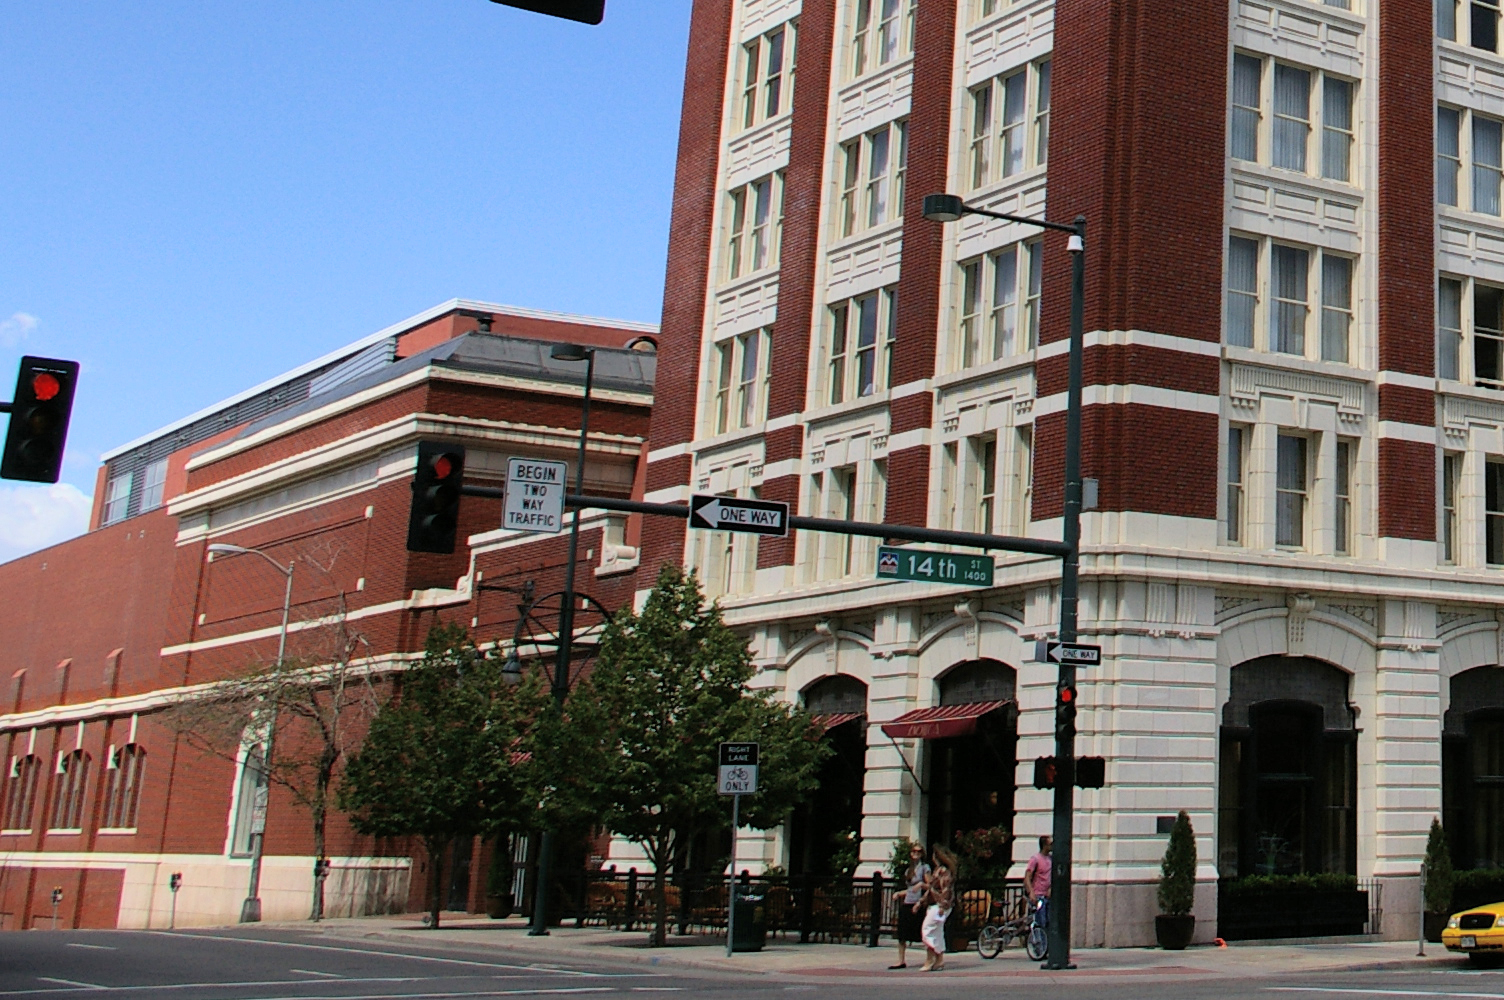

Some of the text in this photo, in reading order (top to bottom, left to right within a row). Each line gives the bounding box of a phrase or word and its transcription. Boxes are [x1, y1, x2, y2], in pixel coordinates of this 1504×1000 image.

[517, 465, 556, 481] BEGIN
[524, 484, 547, 496] TWO
[523, 499, 544, 511] WAY
[509, 511, 554, 527] TRAFFIC
[720, 507, 778, 525] ONE WAY
[908, 555, 957, 579] 14th
[971, 560, 982, 569] ST
[964, 571, 986, 581] 1400
[1062, 649, 1095, 659] ONE WAY
[725, 781, 750, 791] ONLY
